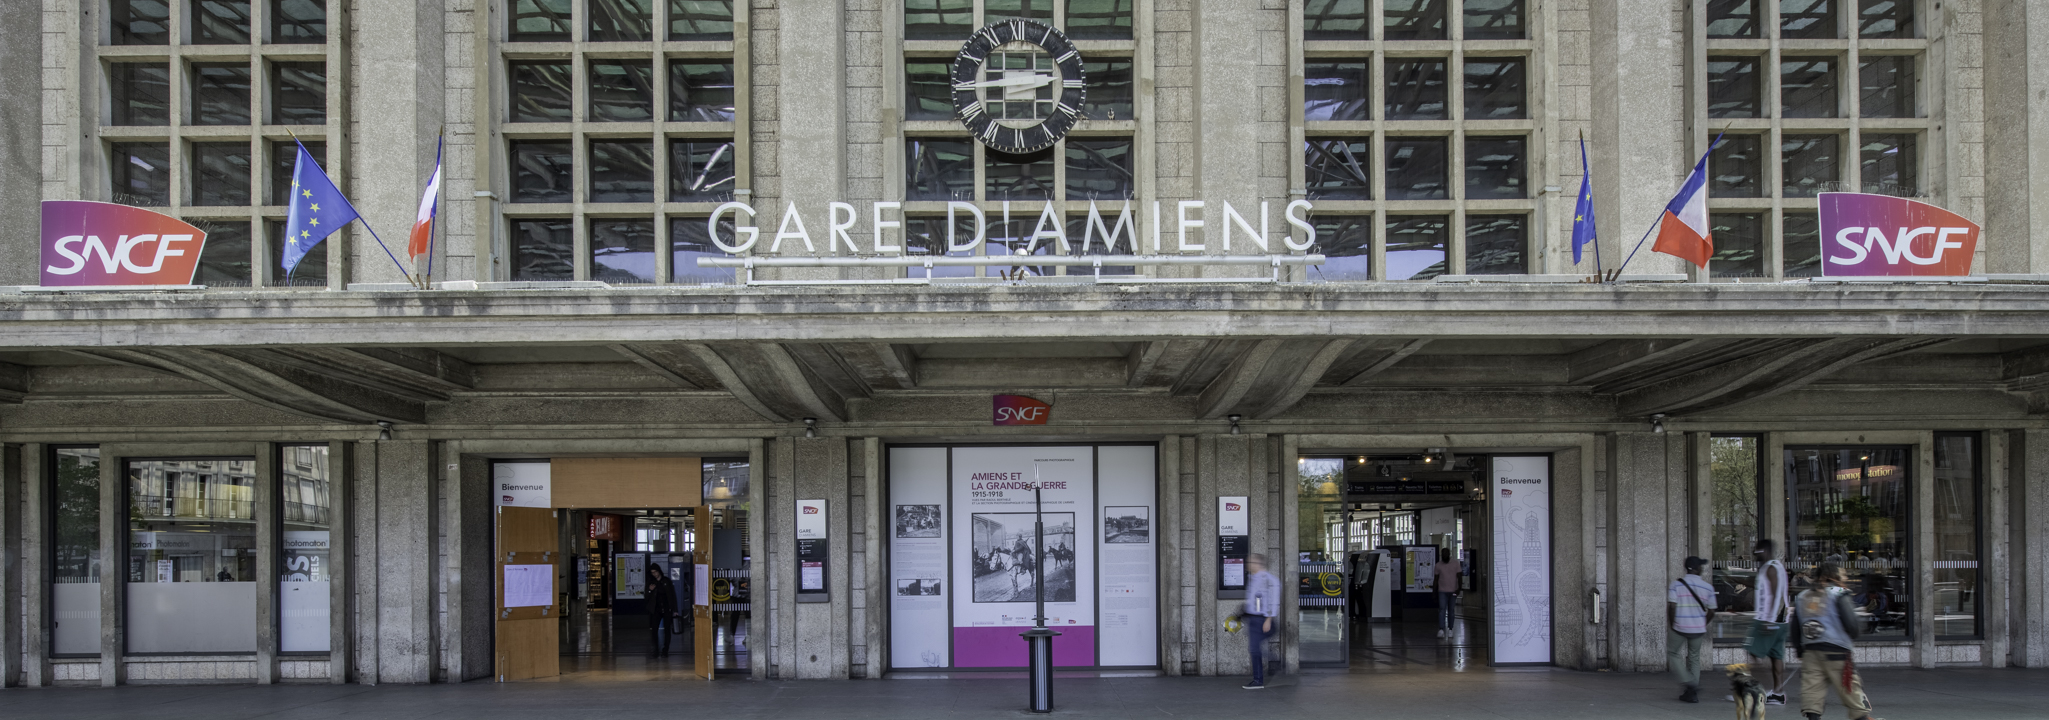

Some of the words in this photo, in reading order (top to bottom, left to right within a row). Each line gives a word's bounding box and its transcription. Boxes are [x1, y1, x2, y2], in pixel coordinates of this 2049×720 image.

[707, 201, 902, 254] GARE
[947, 199, 1317, 254] D'AMIENS
[1829, 226, 1969, 265] SNCF
[46, 233, 193, 275] SNCF
[996, 407, 1046, 421] SNCF
[971, 472, 1008, 481] AMIENS
[1010, 472, 1022, 480] ET
[1501, 477, 1542, 485] Bienvenue
[501, 483, 544, 491] Bienvenue
[971, 482, 983, 490] LA
[986, 481, 1027, 490] GRANDE
[156, 540, 190, 548] Photomaton
